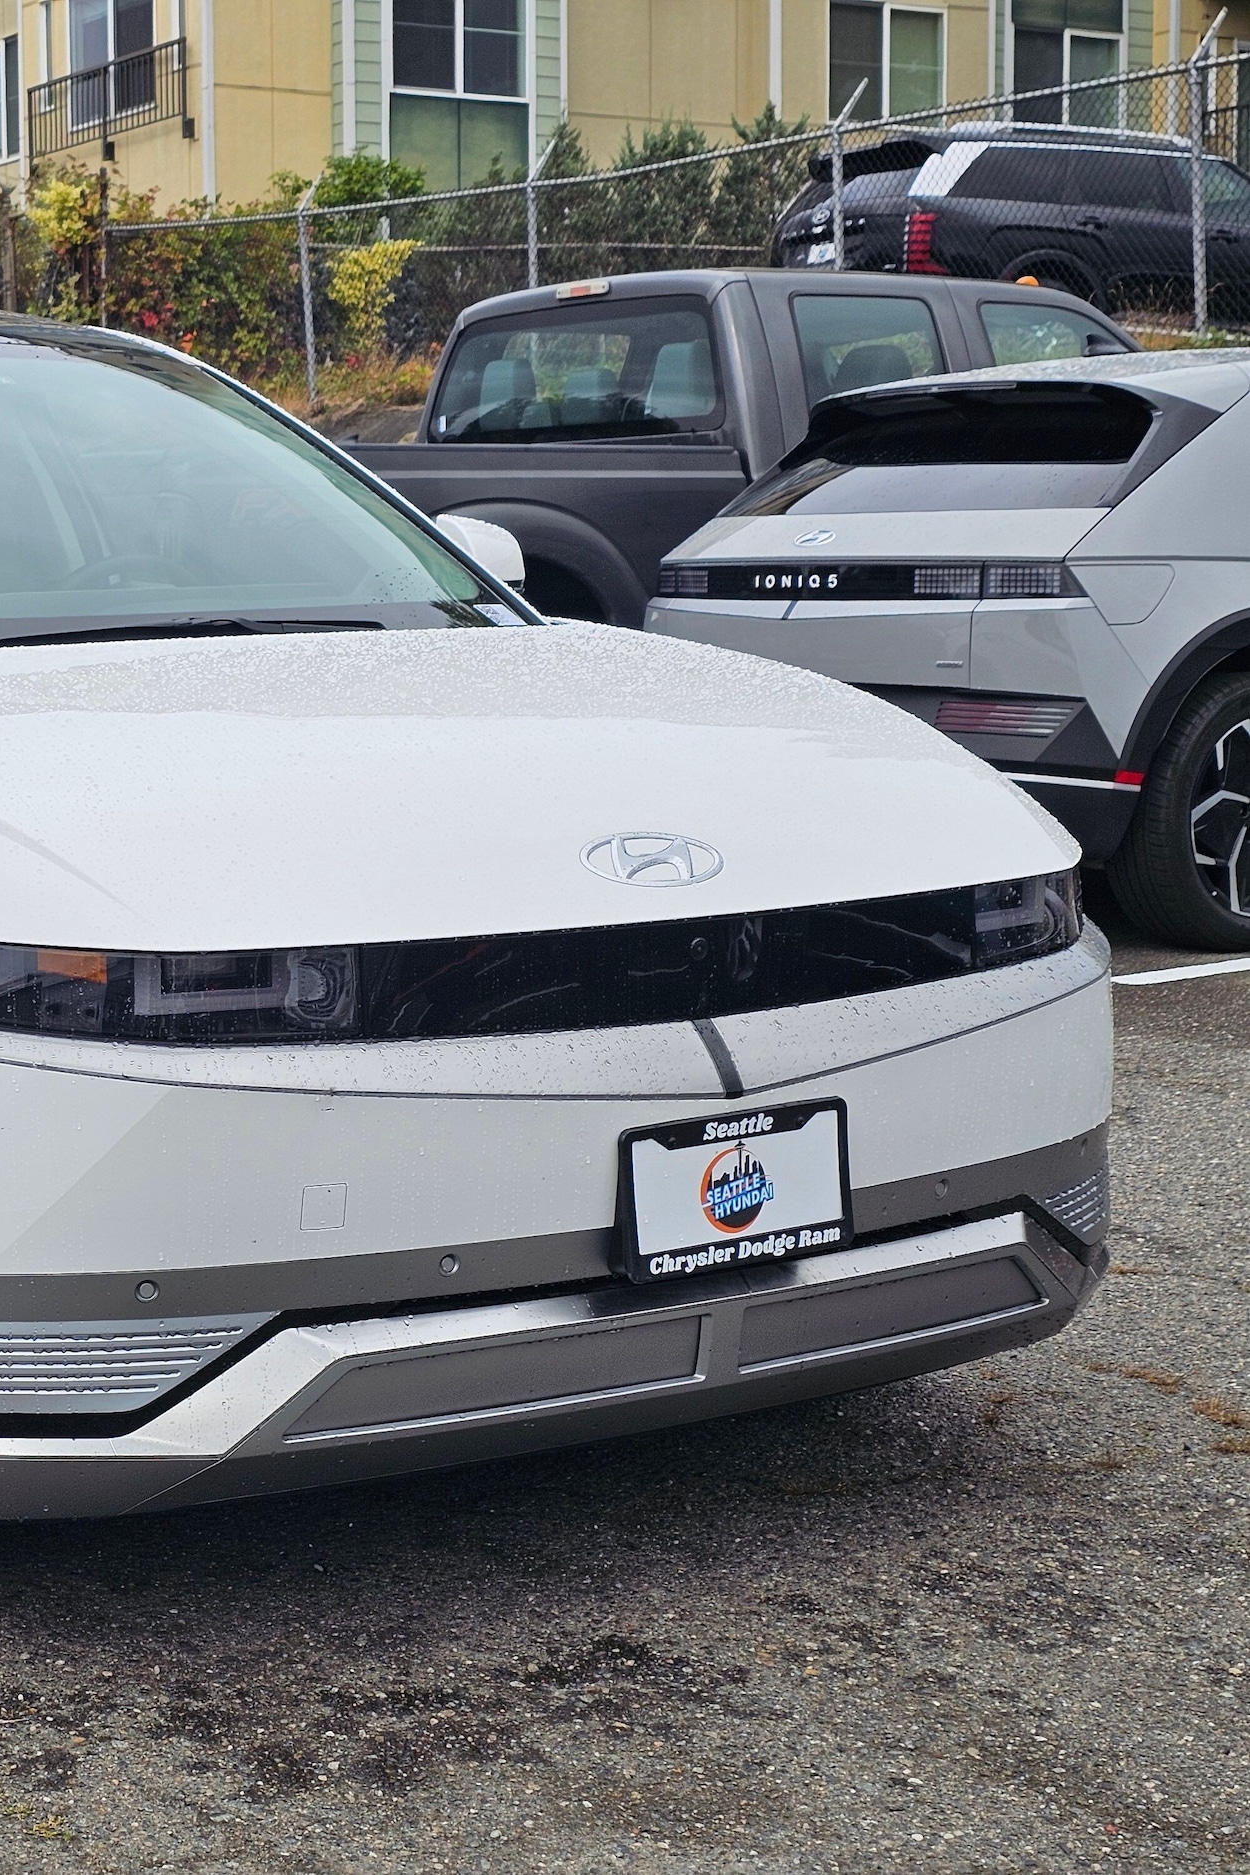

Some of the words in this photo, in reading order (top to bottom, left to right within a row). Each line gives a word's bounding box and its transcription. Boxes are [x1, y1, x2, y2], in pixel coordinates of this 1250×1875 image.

[702, 1112, 774, 1141] Seattle
[706, 1172, 761, 1206] SEATTLE
[714, 1184, 774, 1220] HYUNDAI
[649, 1245, 735, 1275] Chrysler
[737, 1233, 795, 1257] Dodge
[798, 1226, 841, 1248] Ram
